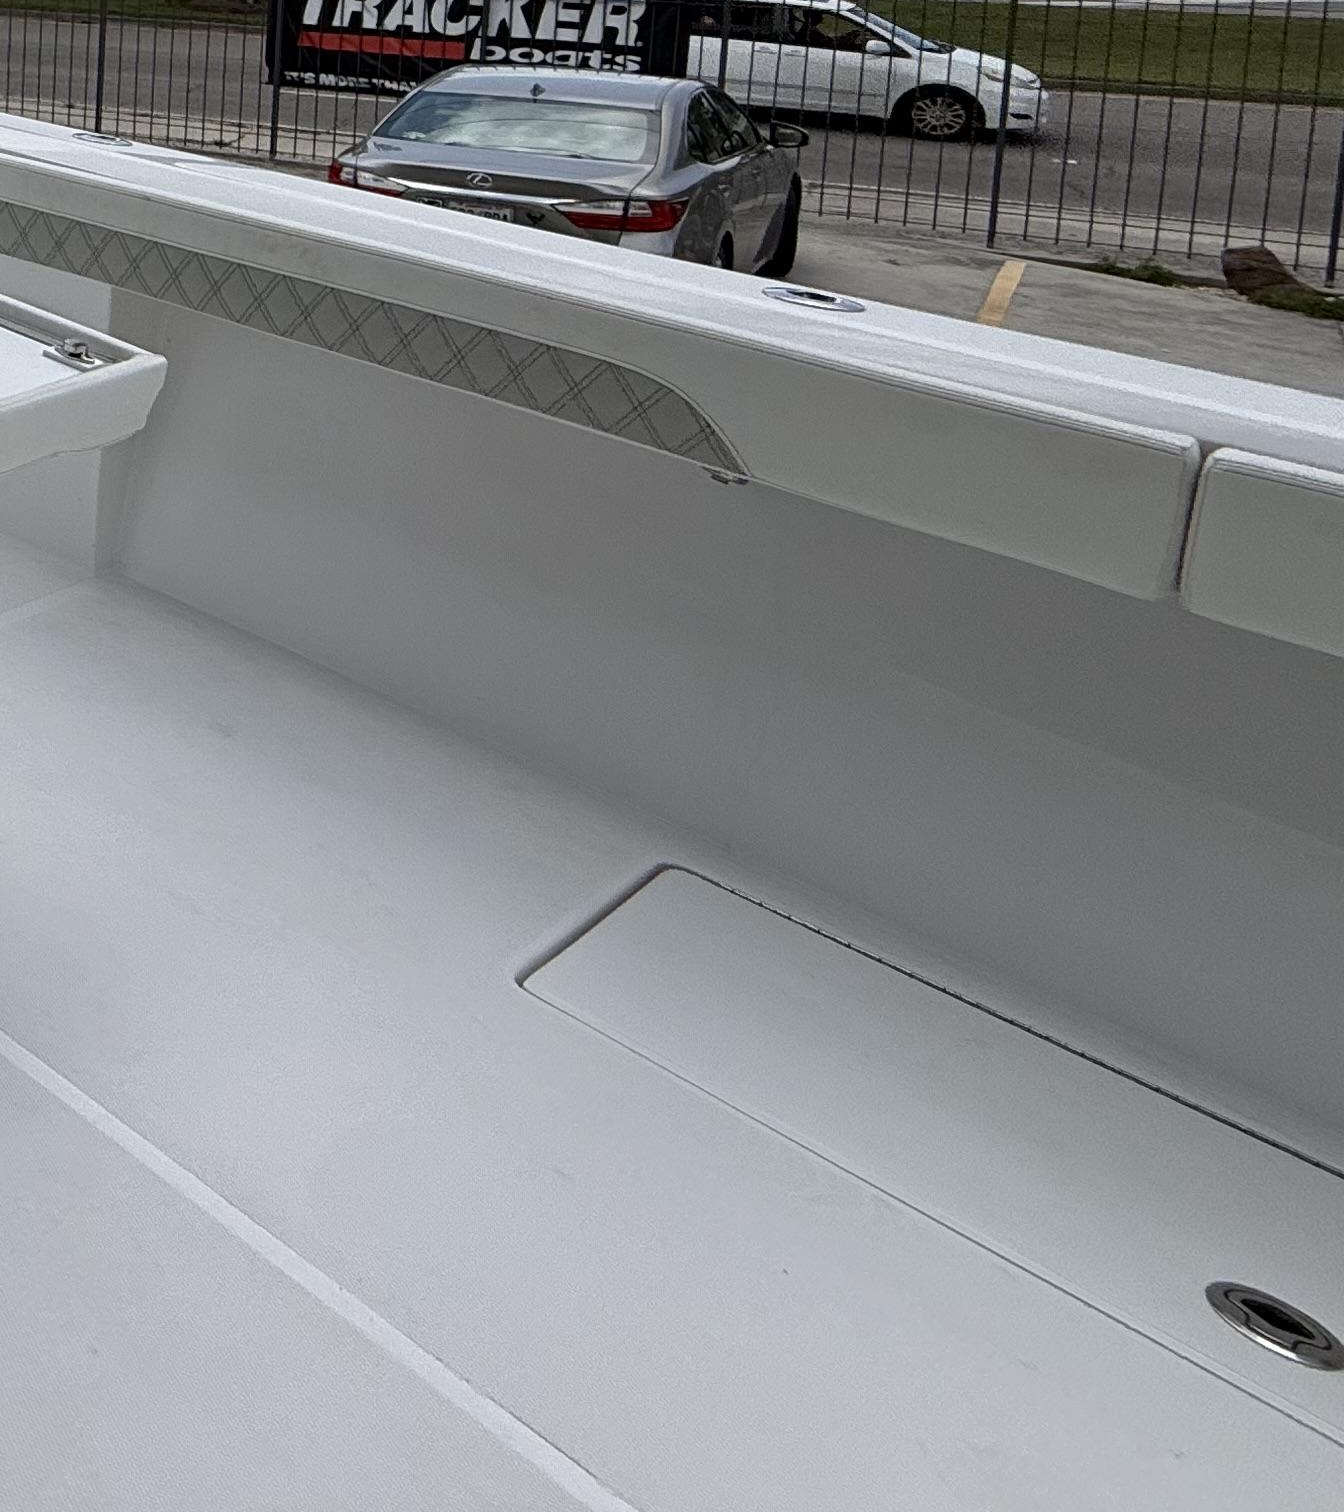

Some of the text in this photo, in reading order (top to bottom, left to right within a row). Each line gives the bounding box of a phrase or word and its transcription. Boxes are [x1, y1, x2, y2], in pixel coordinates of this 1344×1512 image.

[470, 38, 642, 72] boats
[283, 71, 316, 84] IT'S
[318, 73, 371, 88] MORE
